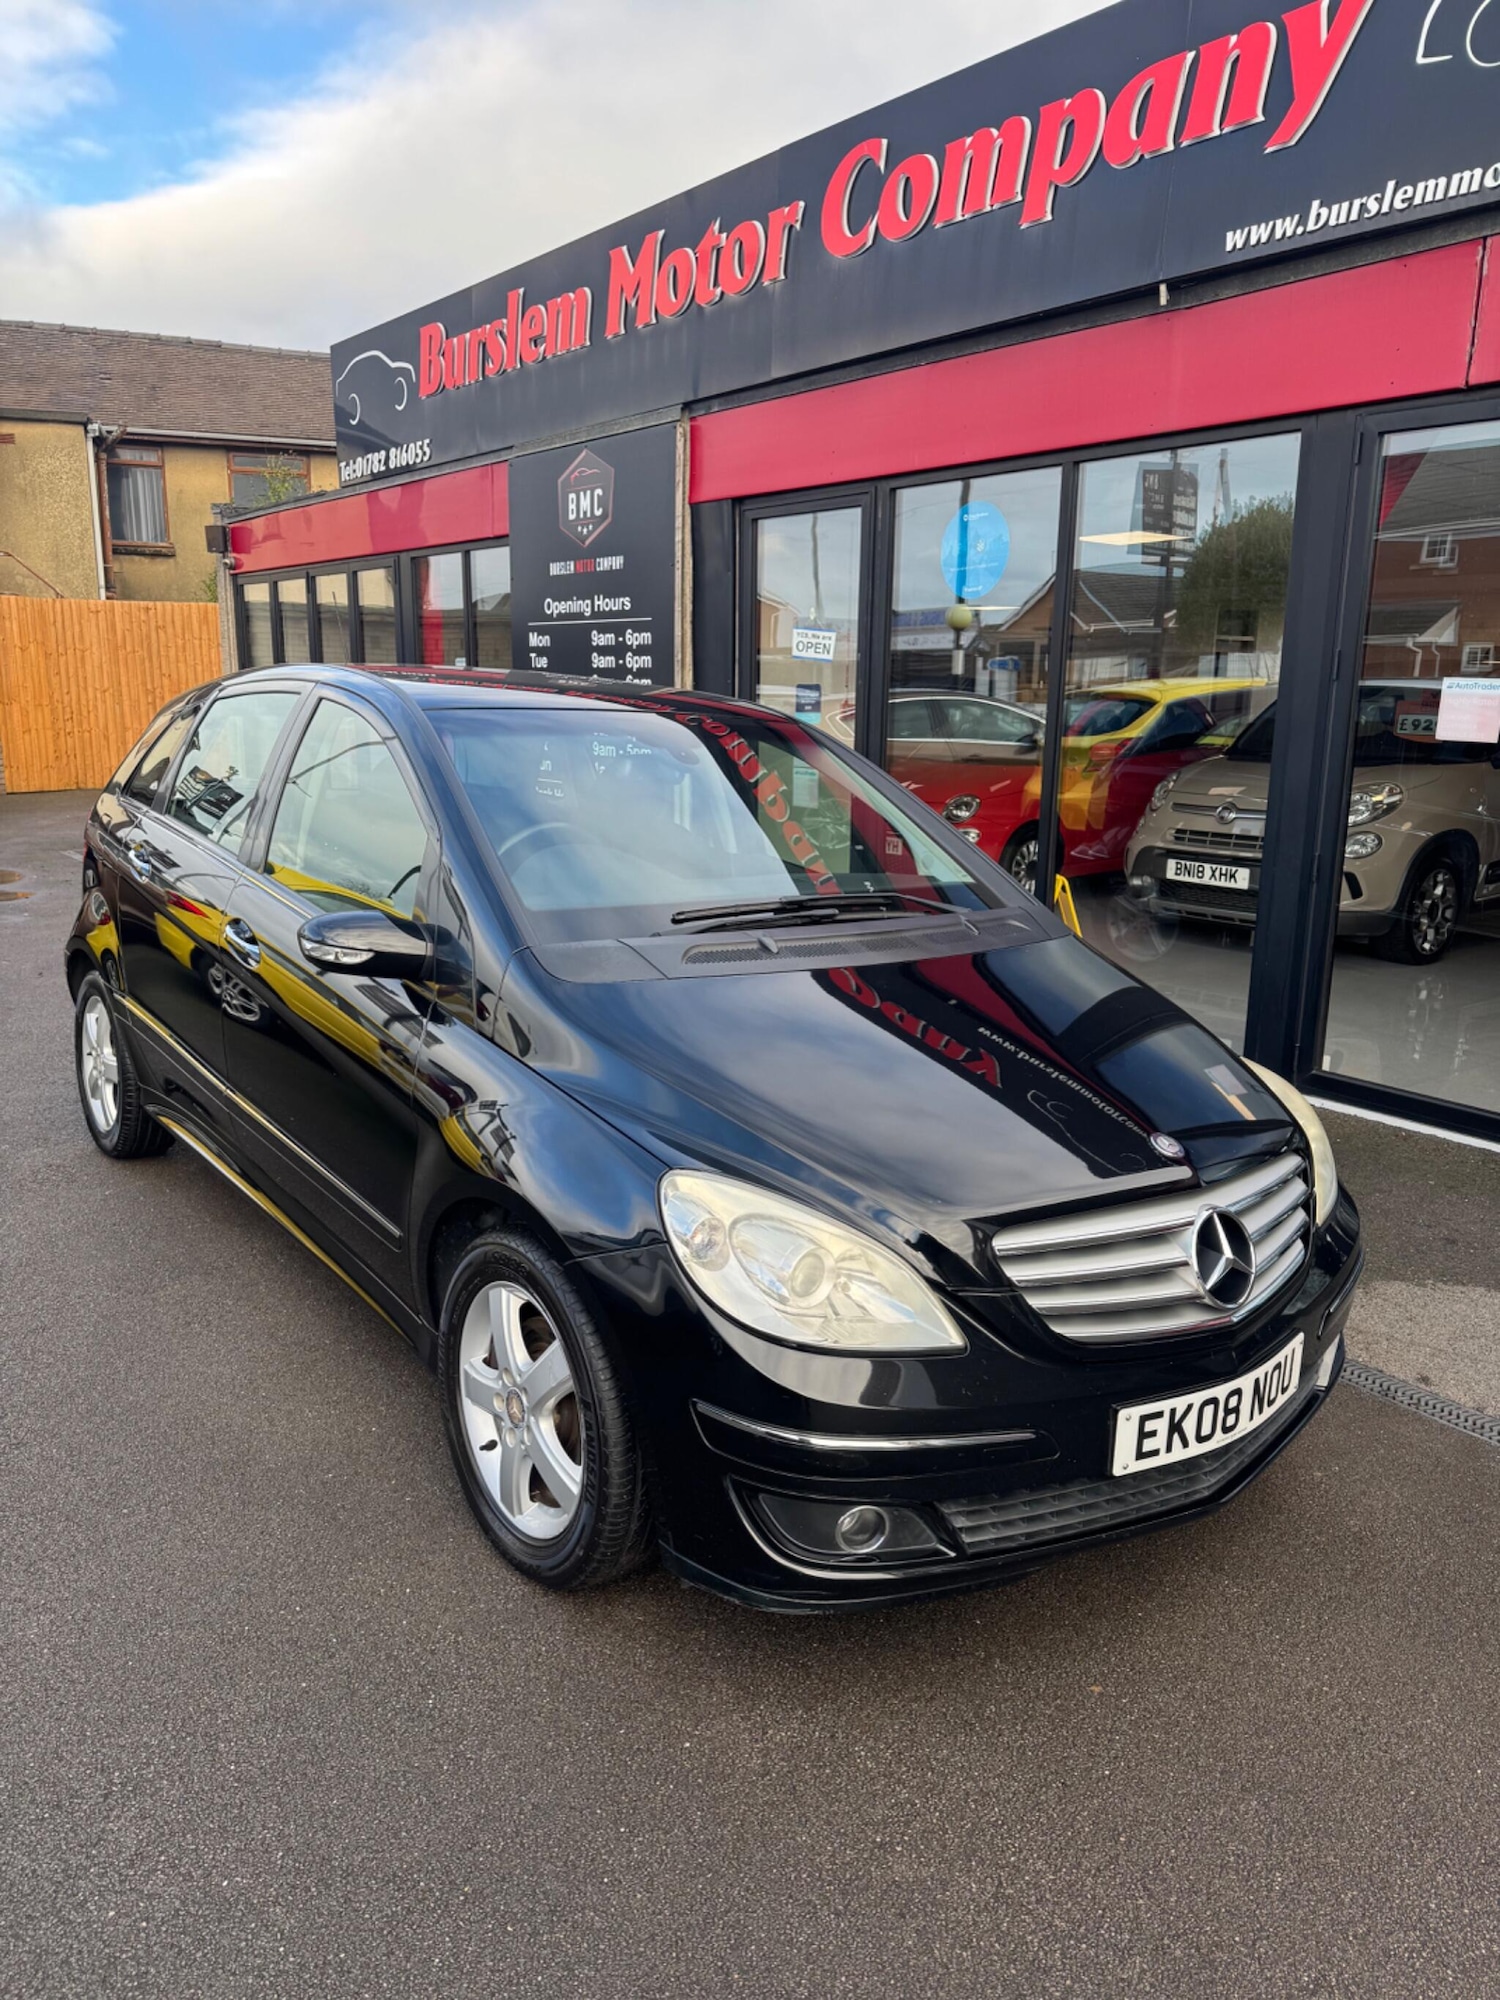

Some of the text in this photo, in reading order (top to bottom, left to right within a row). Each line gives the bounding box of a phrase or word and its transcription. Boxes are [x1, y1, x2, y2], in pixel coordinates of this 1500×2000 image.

[418, 0, 1376, 400] Burslem Motor Company
[339, 438, 431, 481] Tel:01782 816055
[568, 488, 604, 521] BMC
[544, 594, 631, 618] Opening Hours
[528, 631, 551, 647] Mon
[591, 630, 615, 646] 9am
[625, 628, 652, 649] 6pm
[795, 640, 831, 655] OPEN
[529, 653, 549, 668] Tue
[591, 652, 615, 668] 9am
[625, 651, 652, 672] 6pm
[592, 741, 617, 758] 9am
[1174, 861, 1239, 884] BN18 XHK
[1135, 1347, 1296, 1461] EK08 NOU
